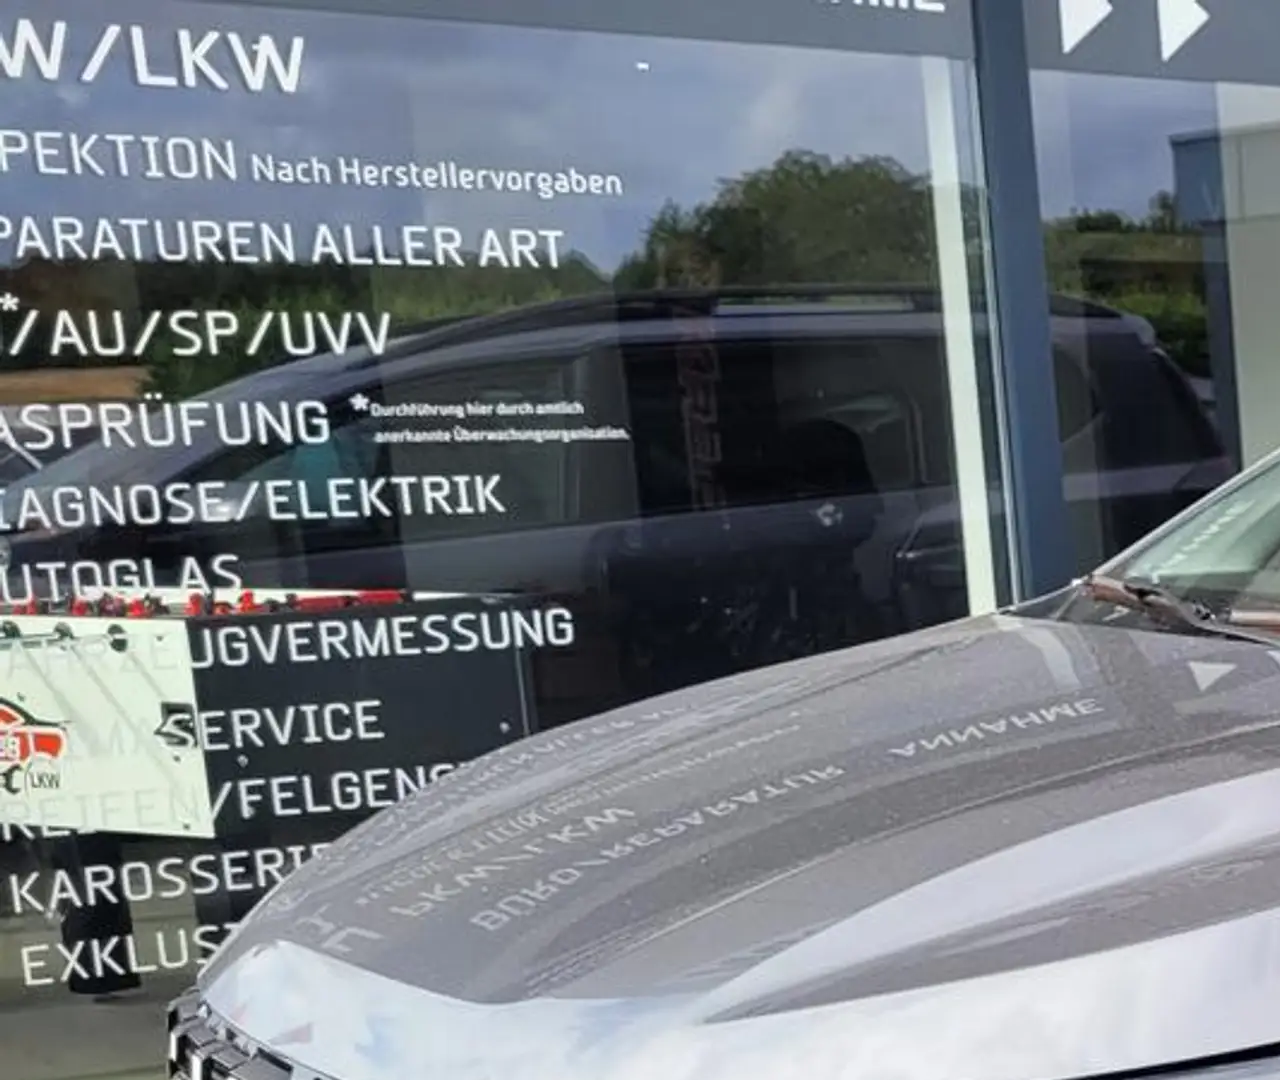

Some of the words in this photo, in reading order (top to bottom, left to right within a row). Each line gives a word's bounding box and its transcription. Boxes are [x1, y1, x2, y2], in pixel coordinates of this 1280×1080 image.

[250, 153, 332, 184] Nach
[338, 156, 624, 199] Herstellervorgaben
[311, 223, 465, 267] ALLER
[479, 227, 564, 269] ART
